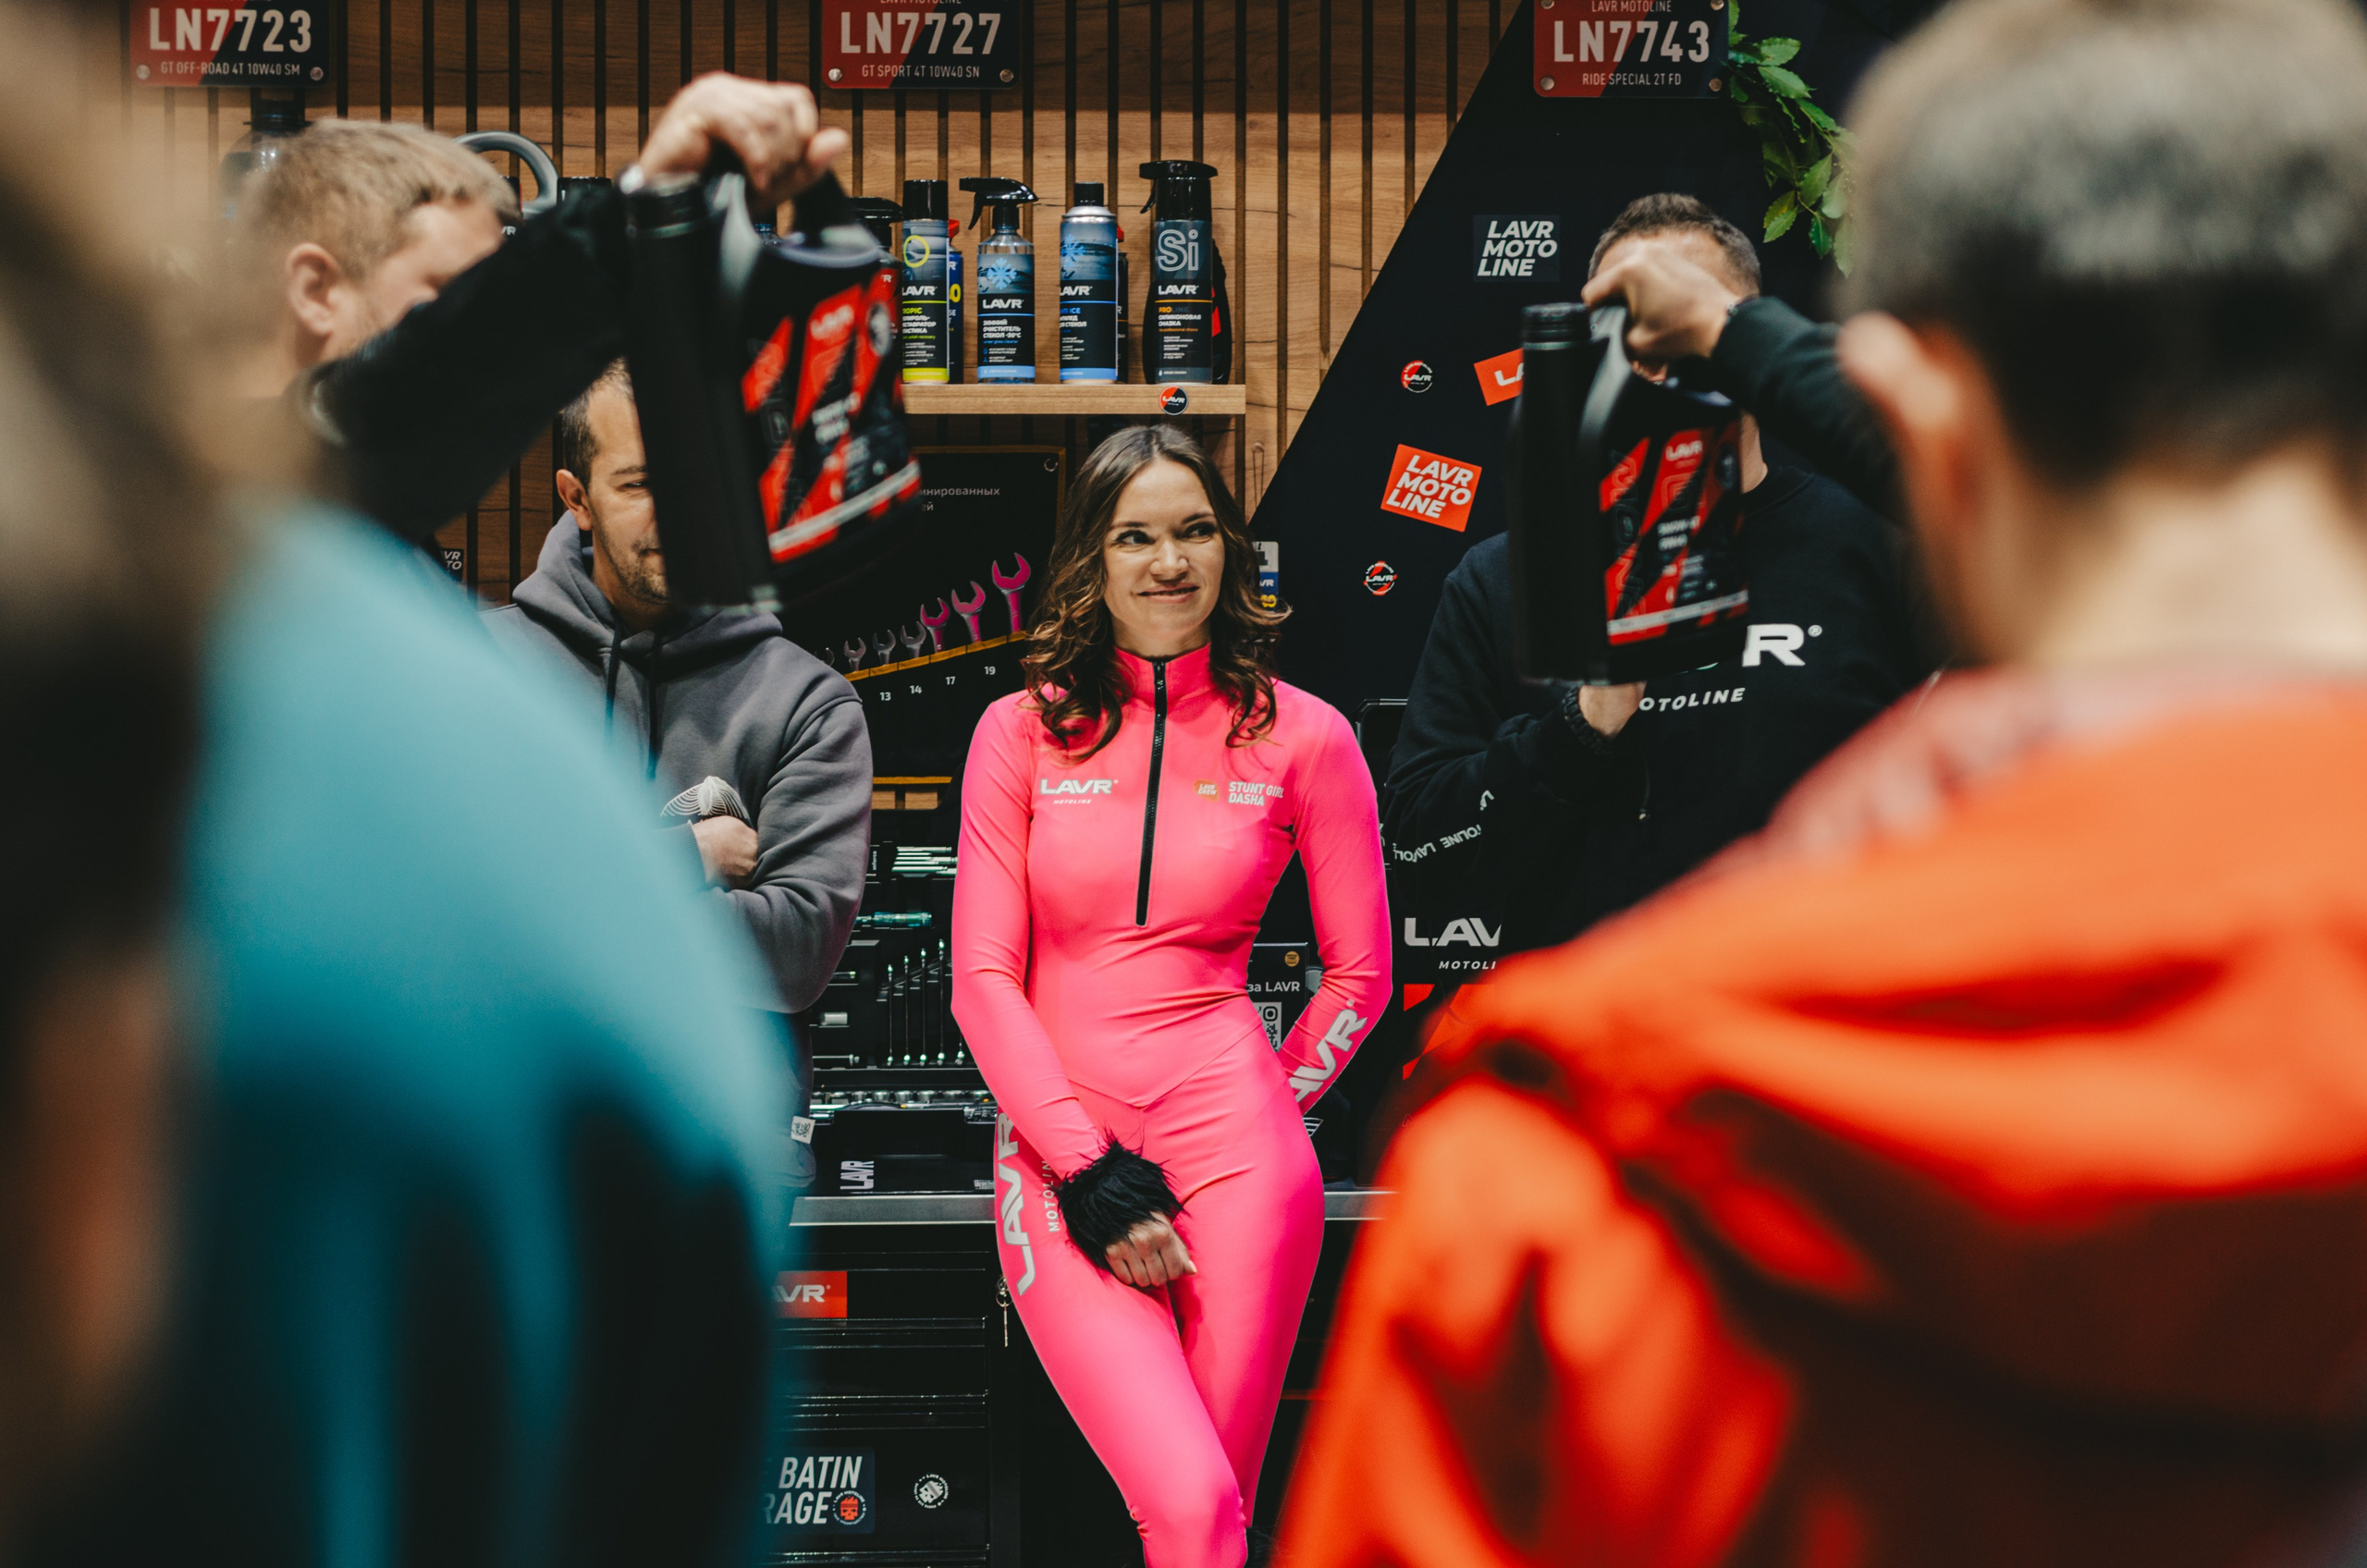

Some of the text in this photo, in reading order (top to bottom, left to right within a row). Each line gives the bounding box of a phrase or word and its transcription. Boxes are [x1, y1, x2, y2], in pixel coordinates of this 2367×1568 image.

[1591, 0, 1672, 13] LAVR MOTOLINE
[150, 7, 312, 53] LN7723
[840, 11, 1001, 55] LN7727
[1554, 20, 1710, 63] LN7743
[161, 61, 300, 76] GT OFF-ROAD 4T 10W40 SM
[862, 65, 980, 78] GT SPORT 4T 10W40 SN
[1582, 73, 1682, 85] RIDE SPECIAL 2T FD
[1487, 220, 1554, 239] LAVR
[1158, 228, 1199, 272] Si
[1482, 239, 1558, 258] MOTO
[1477, 258, 1536, 276] LINE
[1158, 285, 1197, 296] LAVR
[982, 298, 1023, 309] LAVR
[1404, 374, 1432, 382] LAVR
[1405, 454, 1475, 488] LAVR
[1395, 472, 1472, 506] MOTO
[1385, 488, 1447, 519] LINE
[985, 666, 996, 676] 19
[946, 676, 956, 685] 17
[880, 692, 892, 702] 13
[910, 685, 923, 694] 14
[1040, 778, 1113, 795] LAVR
[1229, 780, 1285, 799] STUNT GIRL
[1227, 792, 1265, 807] DASHA
[1439, 961, 1497, 970] MOTOLI
[1265, 981, 1300, 993] LAVR
[840, 1160, 875, 1190] LAVR
[997, 1111, 1036, 1296] LAVR
[778, 1455, 863, 1489] BATIN
